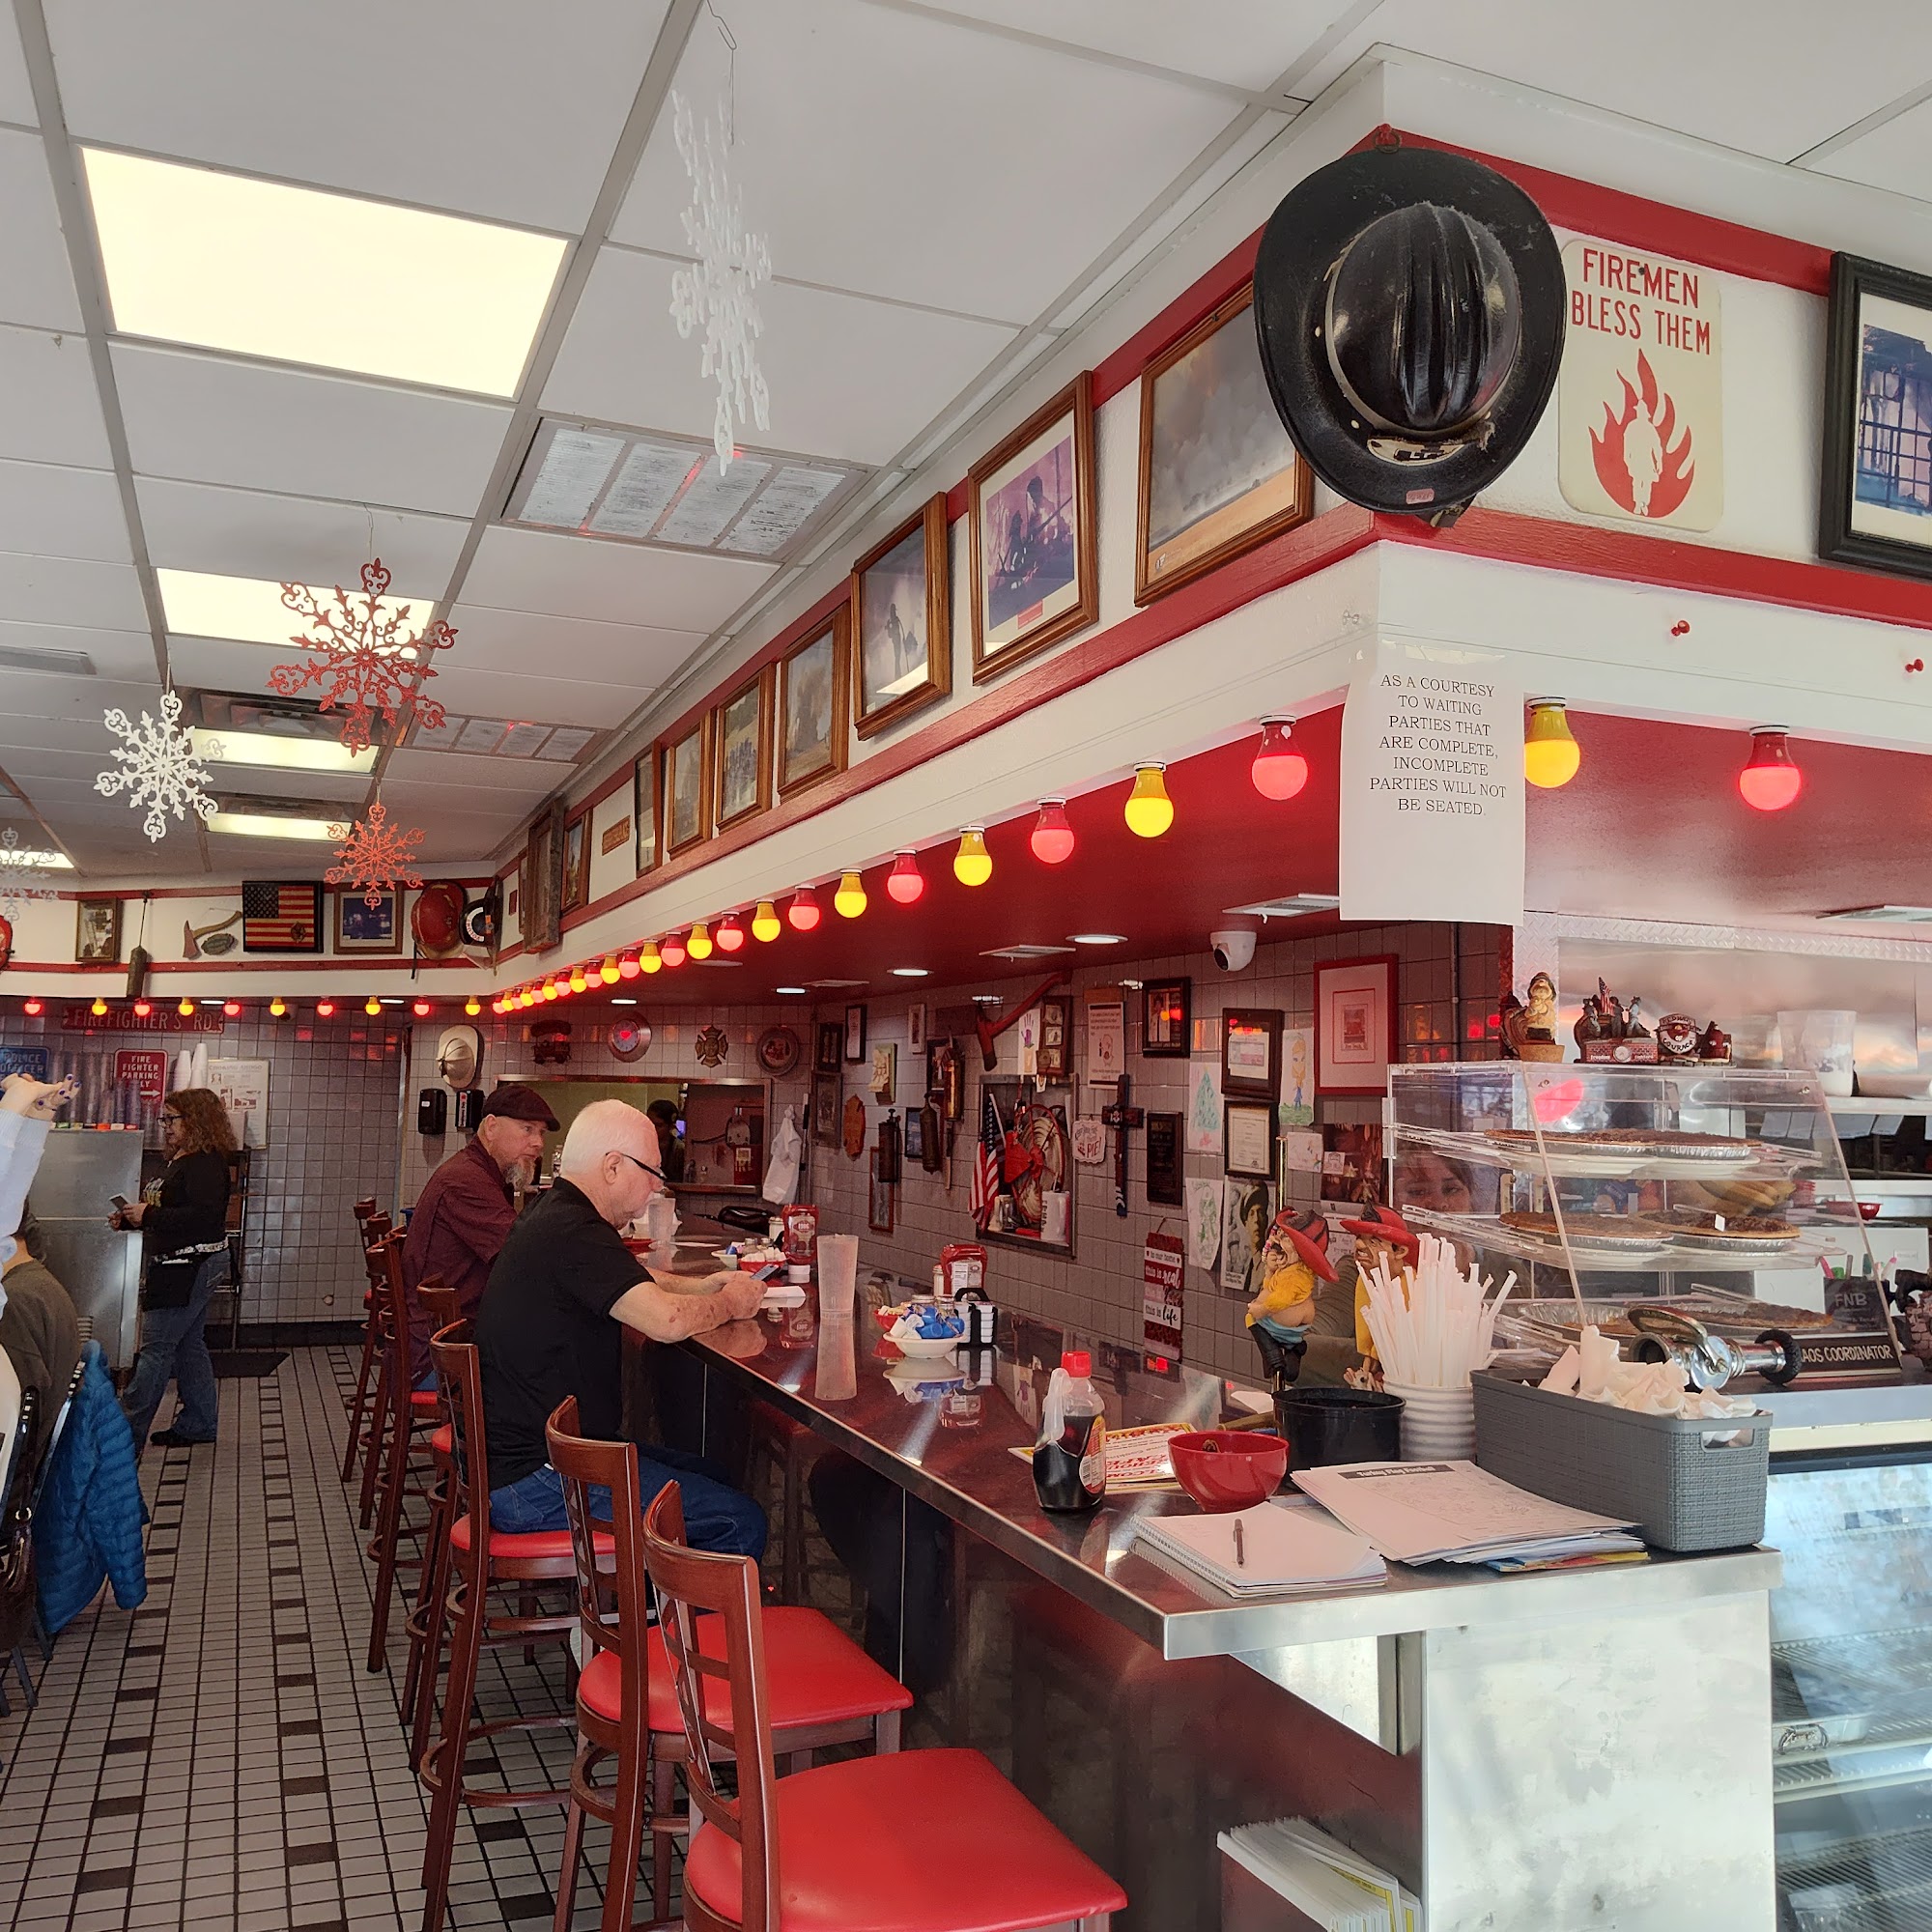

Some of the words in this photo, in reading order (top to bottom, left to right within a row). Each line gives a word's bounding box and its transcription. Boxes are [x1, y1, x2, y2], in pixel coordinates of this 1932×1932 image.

[1583, 248, 1698, 309] FIREMEN
[1572, 290, 1641, 339] BLESS
[1655, 309, 1710, 355] THEM
[1380, 674, 1402, 687] AS
[1406, 676, 1416, 688] A
[1420, 677, 1494, 697] COURTESY
[1398, 695, 1418, 708] TO
[1423, 696, 1482, 716] WAITING
[1389, 715, 1452, 732] PARTIES
[1455, 721, 1491, 736] THAT
[1378, 736, 1413, 749] ARE
[1418, 737, 1498, 759] COMPLETE,
[1393, 756, 1489, 776] INCOMPLETE
[1370, 777, 1438, 791] PARTIES
[1442, 780, 1476, 795] WILL
[1480, 783, 1506, 798] NOT
[1398, 798, 1421, 810] BE
[1426, 799, 1487, 816] SEATED.
[193, 1012, 213, 1031] RD
[4, 1053, 42, 1064] POLICE
[122, 1071, 159, 1080] PARKING
[1163, 1304, 1179, 1325] life
[1802, 1348, 1824, 1363] AOS
[1824, 1345, 1893, 1363] COORDINATOR
